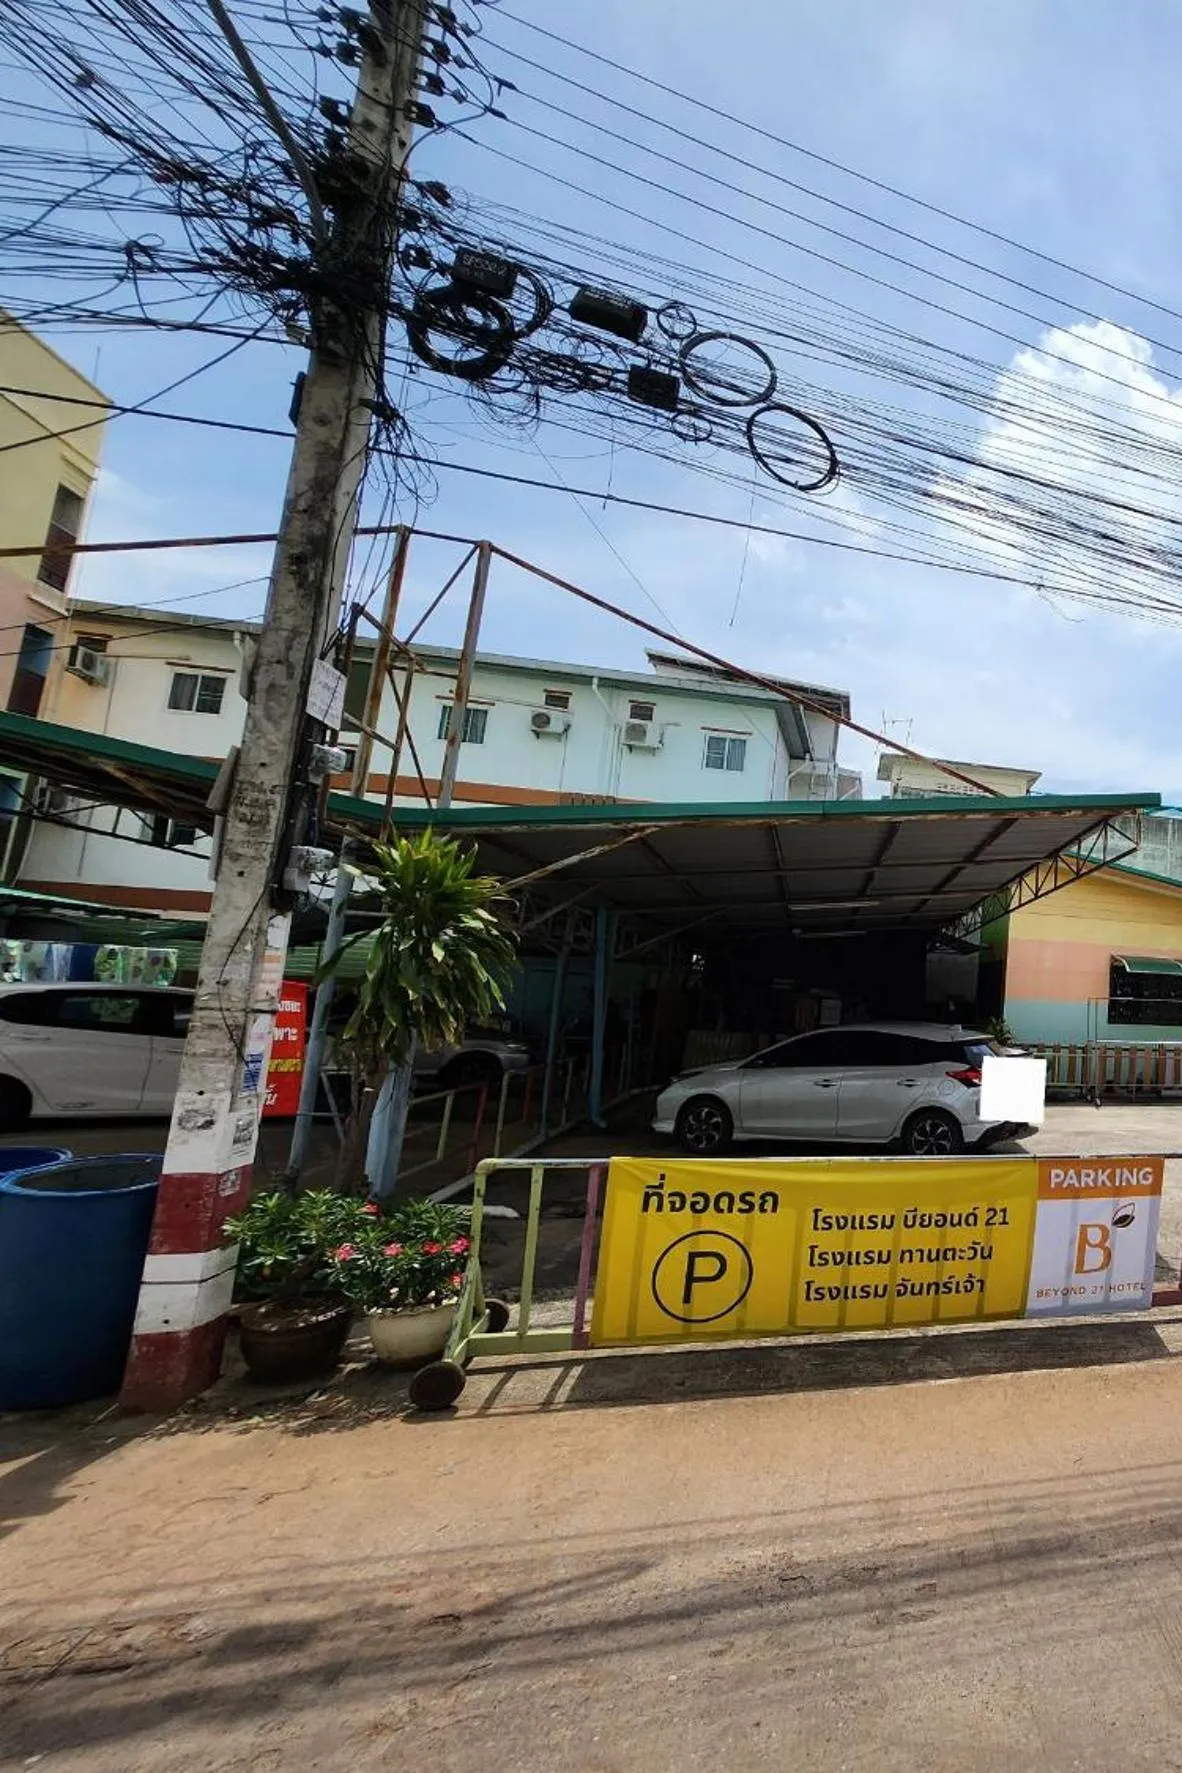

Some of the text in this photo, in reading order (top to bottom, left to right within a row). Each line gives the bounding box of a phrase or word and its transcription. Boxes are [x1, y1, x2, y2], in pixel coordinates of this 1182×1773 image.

[1050, 1167, 1153, 1188] PARKING
[641, 1173, 779, 1214] ที่จอดรถ
[812, 1206, 1009, 1231] โรงแรม บียอนด์ 21
[808, 1241, 993, 1267] โรงแรม ทานตะวัน
[1074, 1223, 1112, 1274] B
[683, 1250, 727, 1304] P
[805, 1273, 985, 1301] โรงแรม จันทร์เจ้า
[1036, 1286, 1087, 1299] BEYOND
[1108, 1282, 1146, 1292] HOTEL
